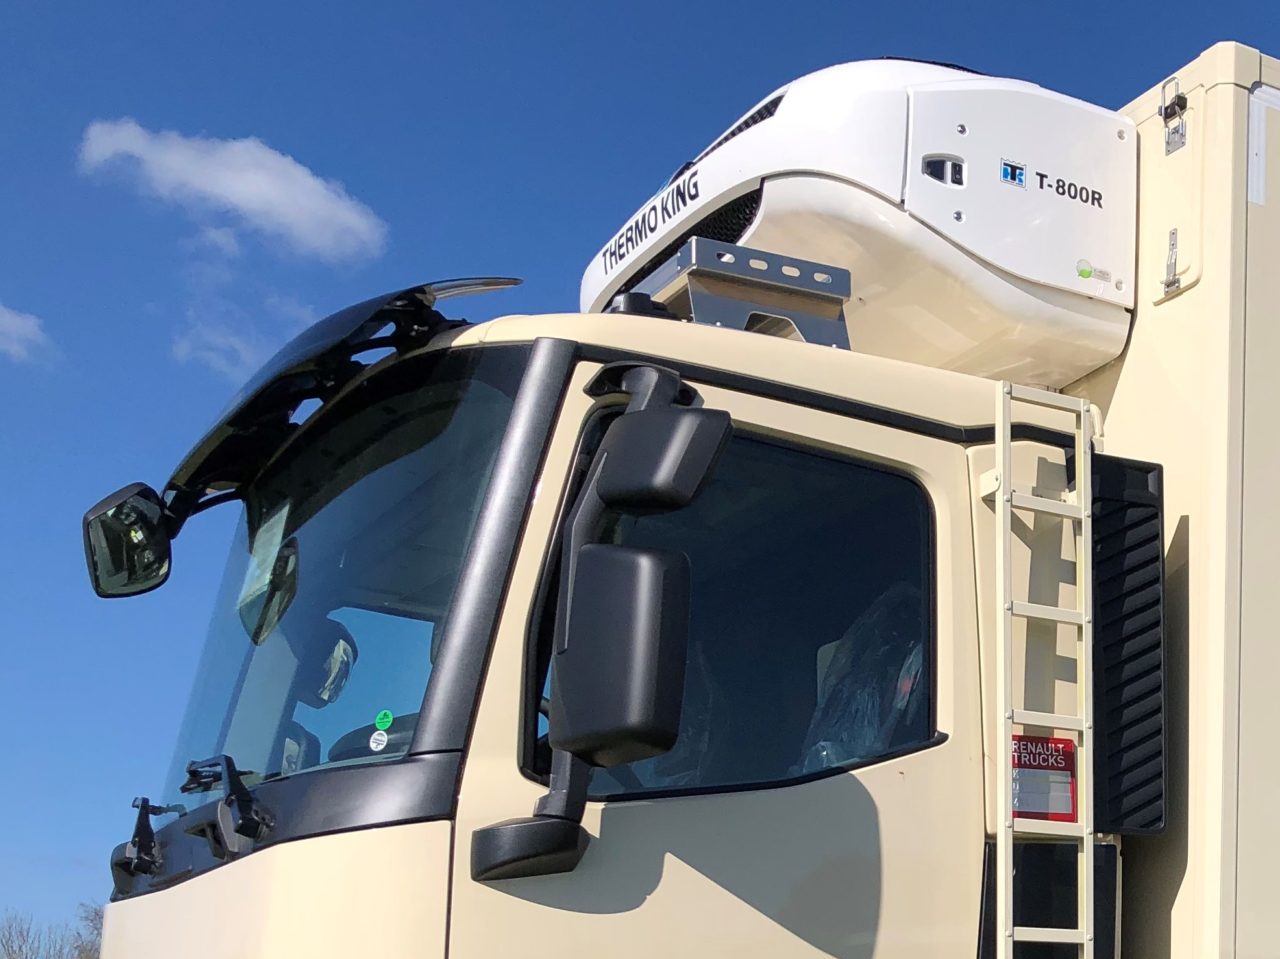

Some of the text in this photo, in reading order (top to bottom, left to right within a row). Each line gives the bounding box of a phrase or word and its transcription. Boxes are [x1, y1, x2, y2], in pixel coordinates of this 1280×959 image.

[1035, 171, 1103, 209] T-800R
[602, 169, 700, 276] THERMO KING
[1012, 741, 1065, 756] RENAULT
[1012, 752, 1066, 767] TRUCKS
